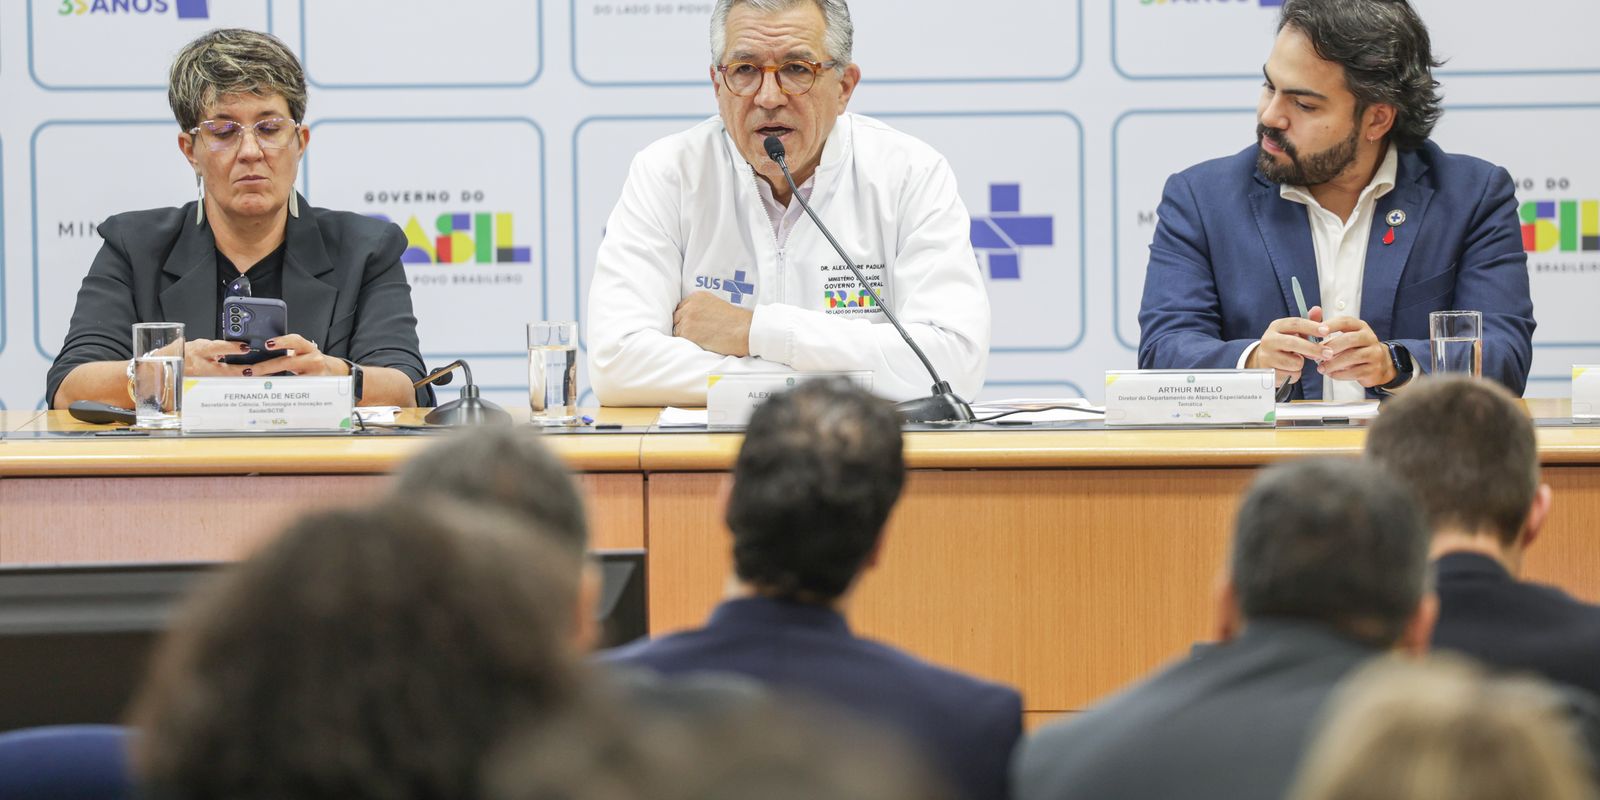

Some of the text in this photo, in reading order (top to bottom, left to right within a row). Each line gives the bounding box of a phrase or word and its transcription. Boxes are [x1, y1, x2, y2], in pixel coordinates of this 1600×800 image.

[364, 190, 485, 203] GOVERNO DO
[452, 273, 523, 285] BRASILEIRO
[695, 275, 721, 290] SUS
[748, 391, 770, 399] ALEX
